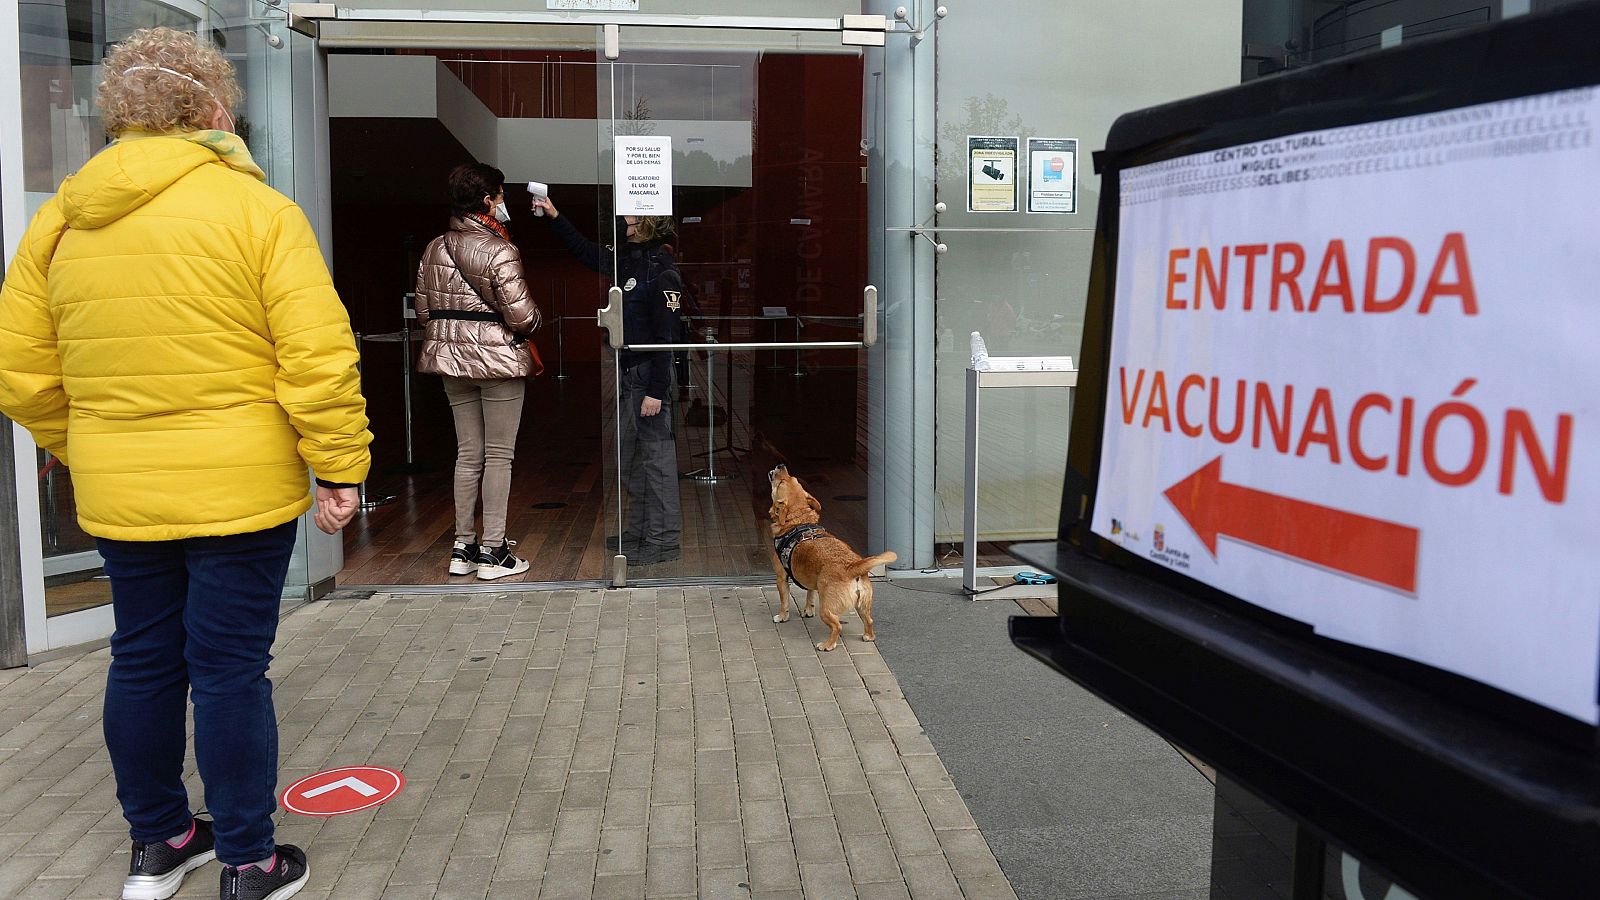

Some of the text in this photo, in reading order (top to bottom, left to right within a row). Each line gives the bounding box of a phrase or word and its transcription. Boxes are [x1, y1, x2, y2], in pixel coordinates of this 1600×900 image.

[1213, 135, 1325, 163] CENTRO CULTURAL
[1241, 158, 1282, 172] MIGUEL
[1258, 169, 1310, 186] DELIBES
[1166, 233, 1478, 315] ENTRADA
[1120, 368, 1574, 505] VACUNACIÓN
[1165, 546, 1190, 559] Junta de
